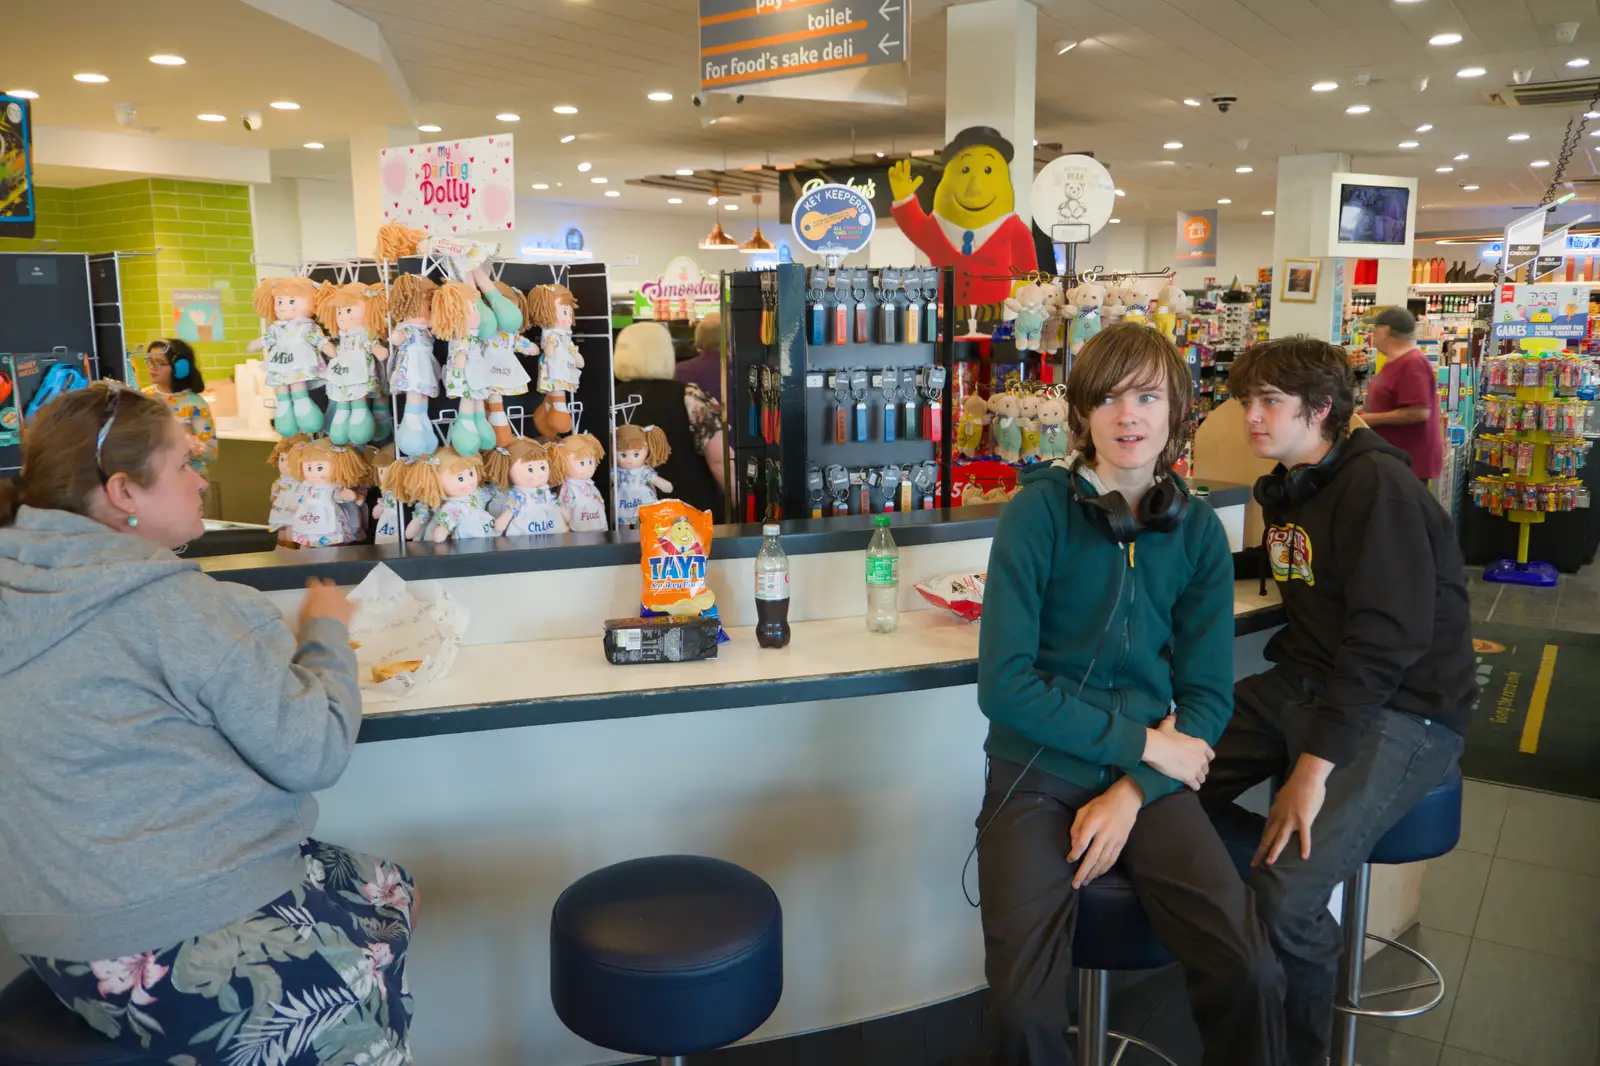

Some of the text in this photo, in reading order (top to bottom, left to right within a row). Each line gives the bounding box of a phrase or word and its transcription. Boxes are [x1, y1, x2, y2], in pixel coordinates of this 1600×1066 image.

[807, 7, 852, 31] toilet
[705, 39, 853, 80] for food's sake deli
[421, 161, 469, 180] Darling
[420, 178, 470, 209] Dolly
[803, 189, 867, 213] KEY KEEPERS
[1496, 324, 1527, 337] GAMES
[649, 555, 710, 580] TAYT
